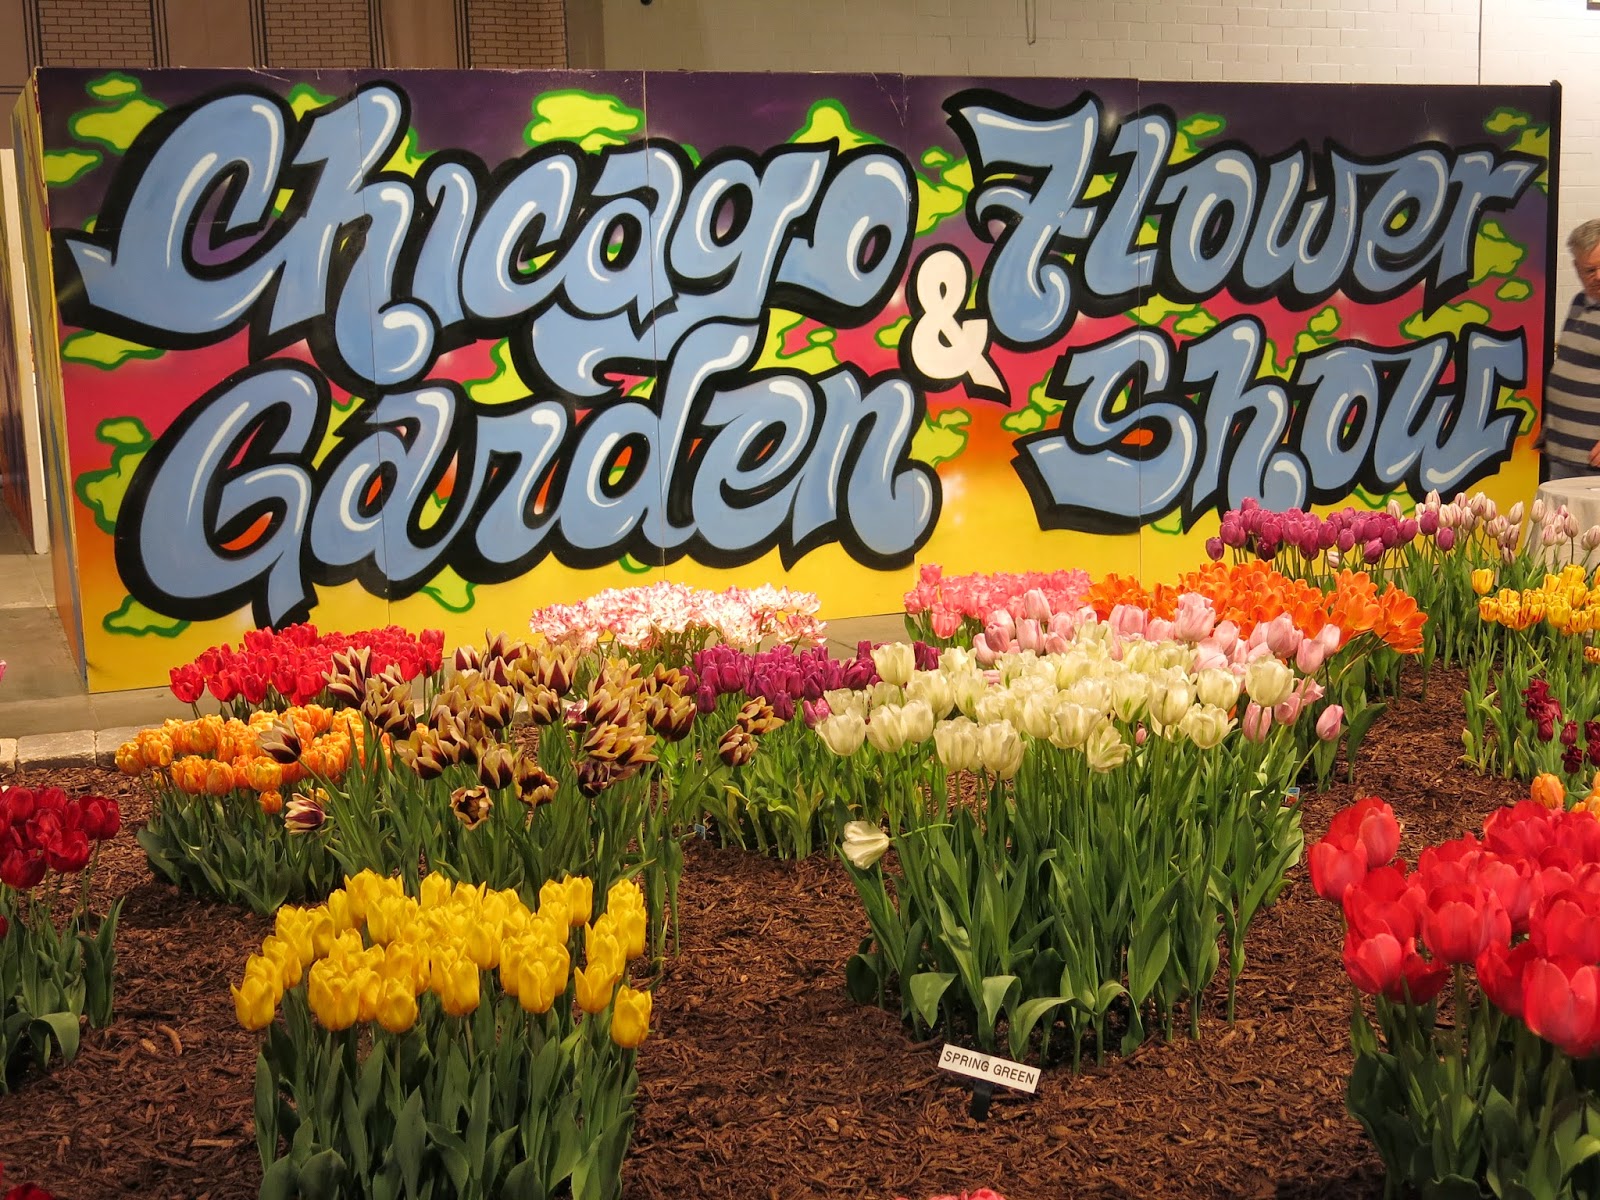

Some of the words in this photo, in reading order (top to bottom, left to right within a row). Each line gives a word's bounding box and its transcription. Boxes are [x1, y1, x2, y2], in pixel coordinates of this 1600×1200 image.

[64, 83, 910, 399] Chicago
[944, 96, 1538, 344] Flower
[910, 248, 1004, 394] &
[136, 319, 936, 622] Garden
[1024, 315, 1526, 512] Show
[943, 1050, 989, 1072] SPRING
[993, 1064, 1035, 1085] GREEN
